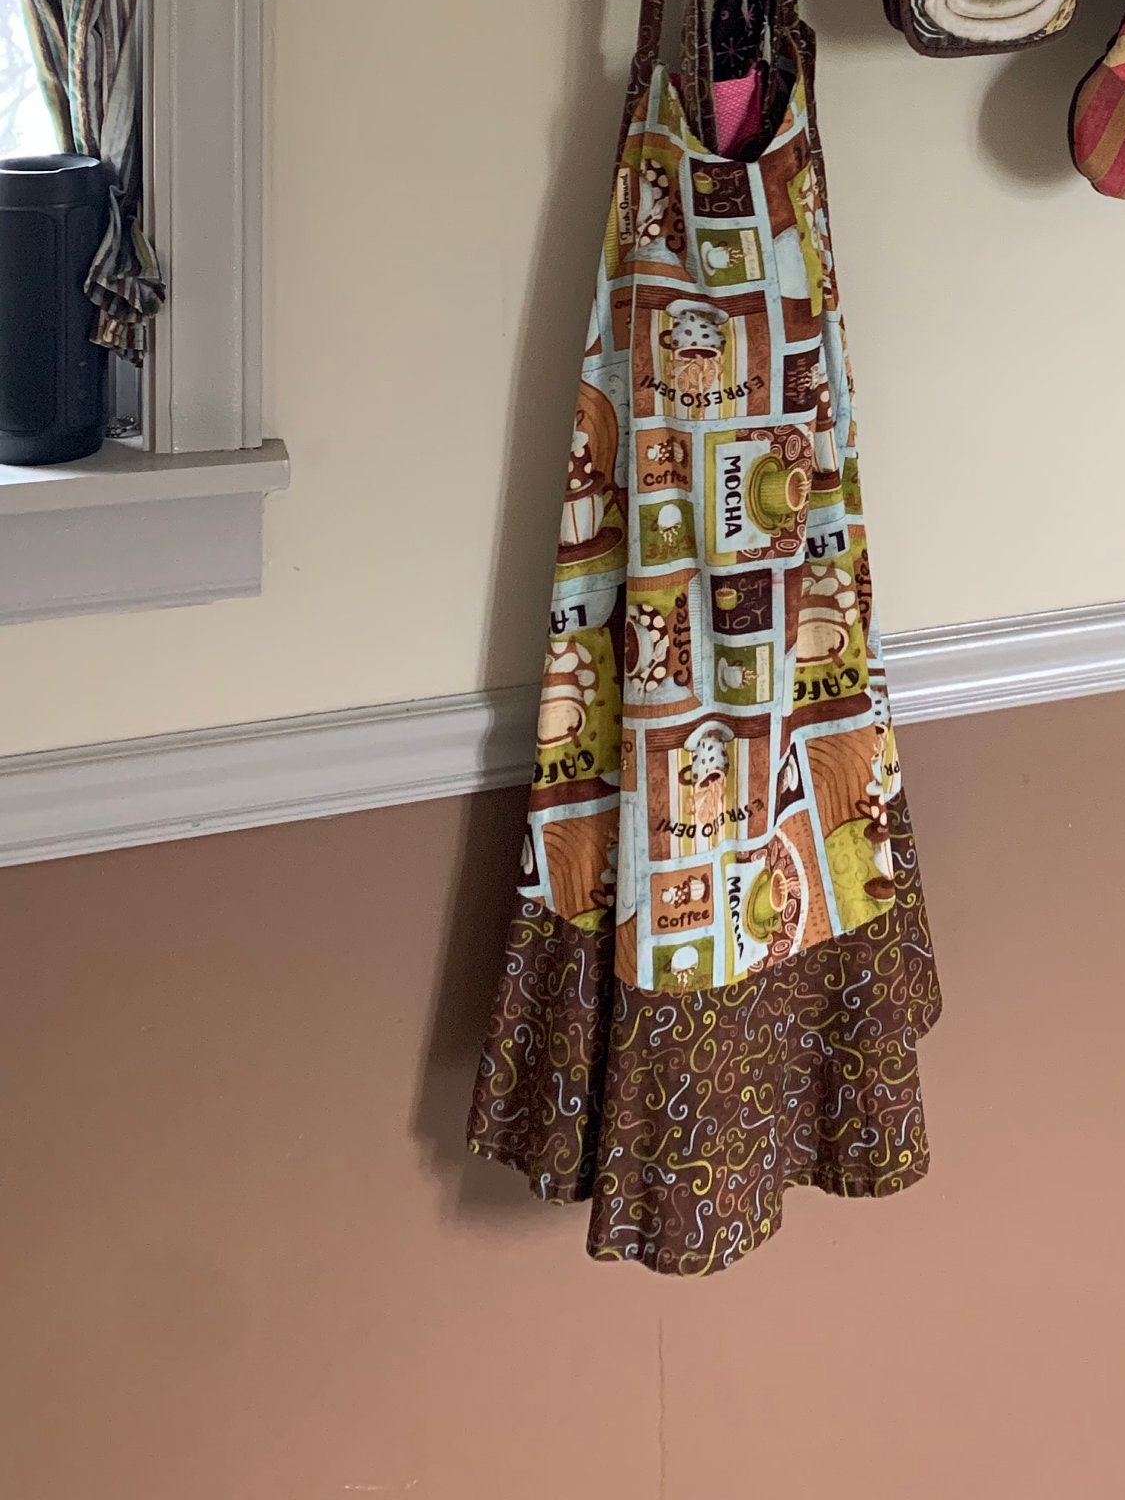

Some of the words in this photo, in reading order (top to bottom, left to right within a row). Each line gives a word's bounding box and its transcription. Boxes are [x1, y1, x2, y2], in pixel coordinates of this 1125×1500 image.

[700, 194, 746, 212] JOY
[640, 375, 676, 402] DEMI
[680, 375, 765, 408] ESPRESSO
[643, 470, 689, 486] Coffee
[724, 456, 743, 539] MOCHA
[719, 605, 767, 629] JOY
[673, 592, 691, 687] Coffee
[655, 819, 696, 839] DEMI
[657, 909, 711, 929] Coffee
